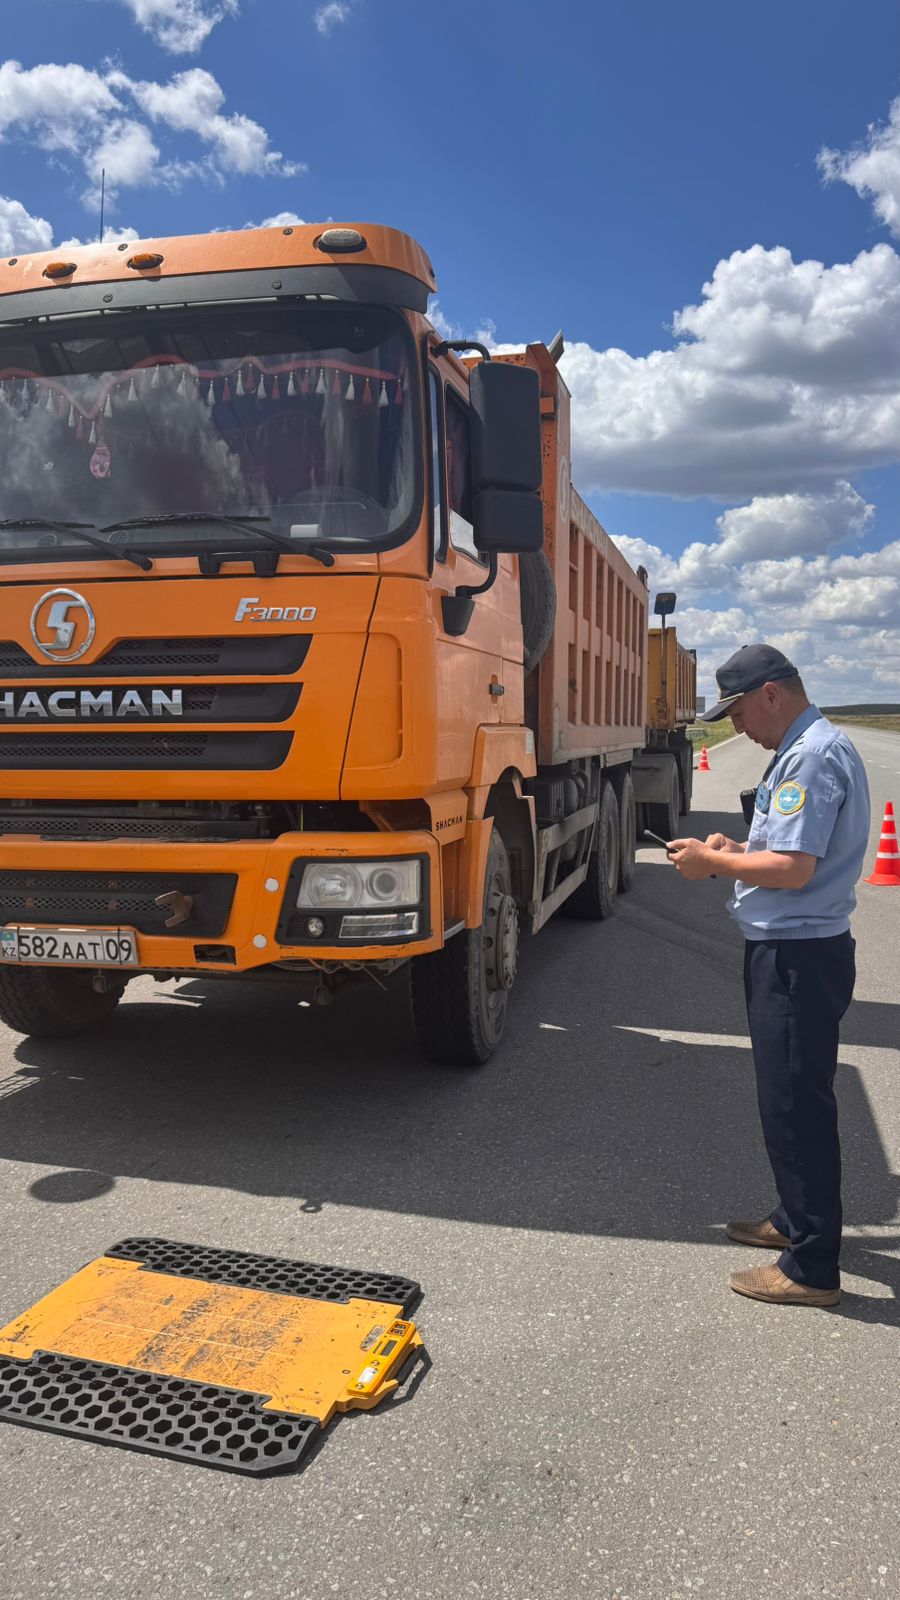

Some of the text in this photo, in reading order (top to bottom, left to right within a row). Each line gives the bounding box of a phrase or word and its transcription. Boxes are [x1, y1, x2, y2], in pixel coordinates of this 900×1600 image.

[234, 597, 317, 622] F3000
[436, 815, 463, 831] SHACMAN
[2, 947, 16, 957] KZ
